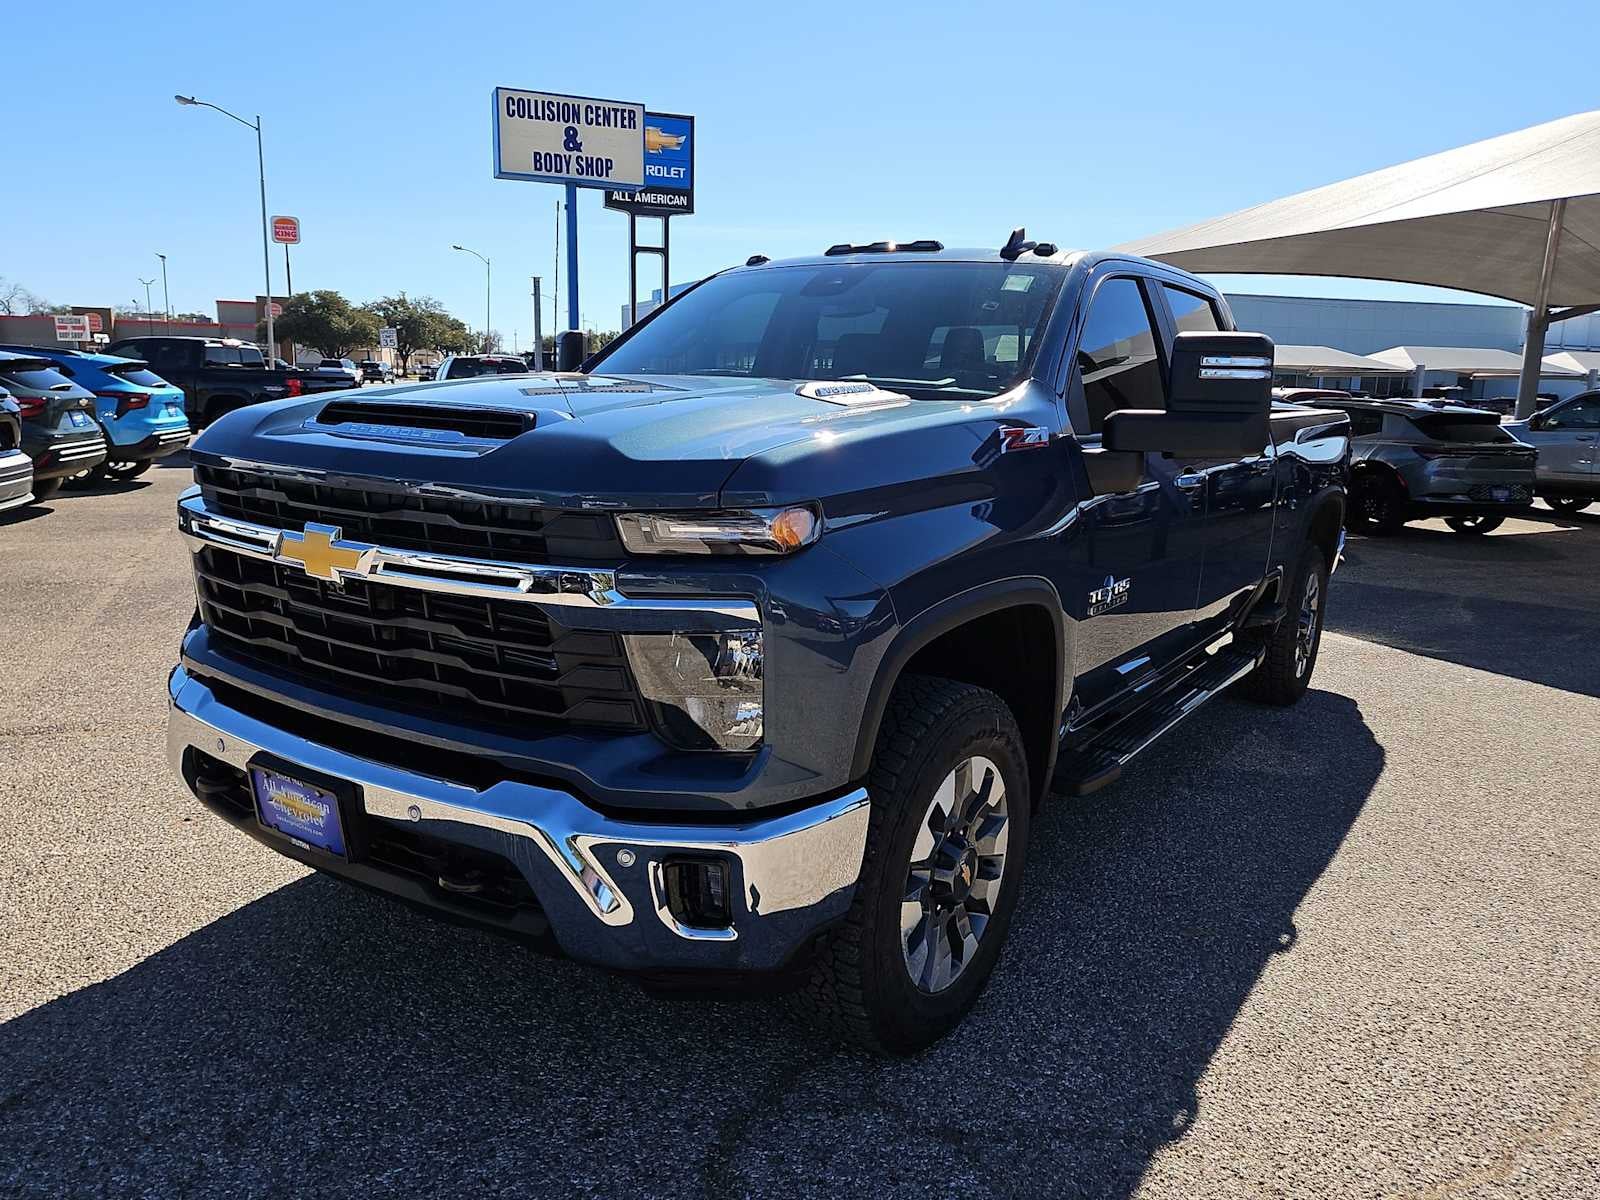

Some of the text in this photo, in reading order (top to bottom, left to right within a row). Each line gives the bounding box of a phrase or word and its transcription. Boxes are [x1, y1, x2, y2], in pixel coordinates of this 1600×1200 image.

[506, 96, 637, 130] COLLISION CENTER
[563, 126, 583, 153] &
[533, 151, 613, 178] BODY SHOP
[645, 164, 686, 178] ROLET
[612, 190, 688, 206] ALL AMERICAN
[274, 230, 297, 238] KING
[382, 339, 396, 347] 35
[999, 425, 1049, 454] Z71
[272, 796, 325, 828] Chevrolet
[280, 785, 330, 815] American
